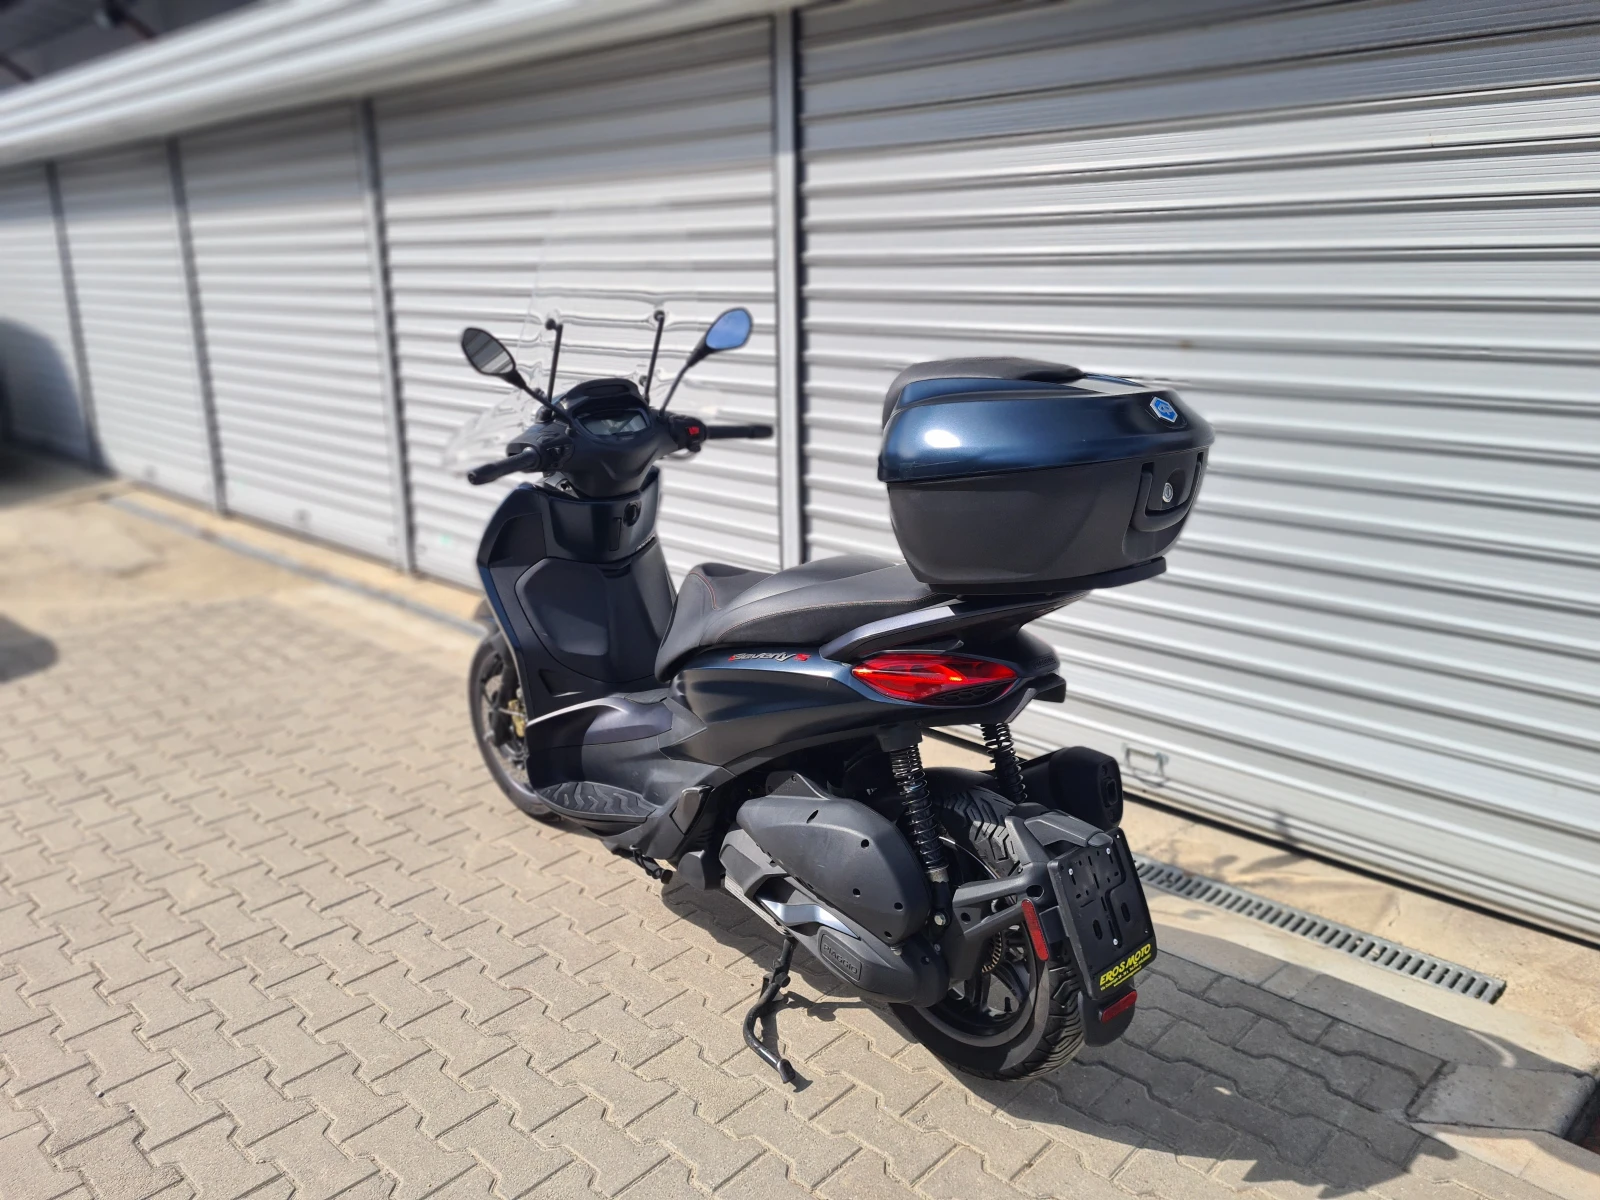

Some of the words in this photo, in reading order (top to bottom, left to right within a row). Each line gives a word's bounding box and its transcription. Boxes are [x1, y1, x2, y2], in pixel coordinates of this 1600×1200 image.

[823, 944, 858, 975] PIAGGIO
[1100, 961, 1125, 985] EROS
[1126, 943, 1151, 968] MOTO
